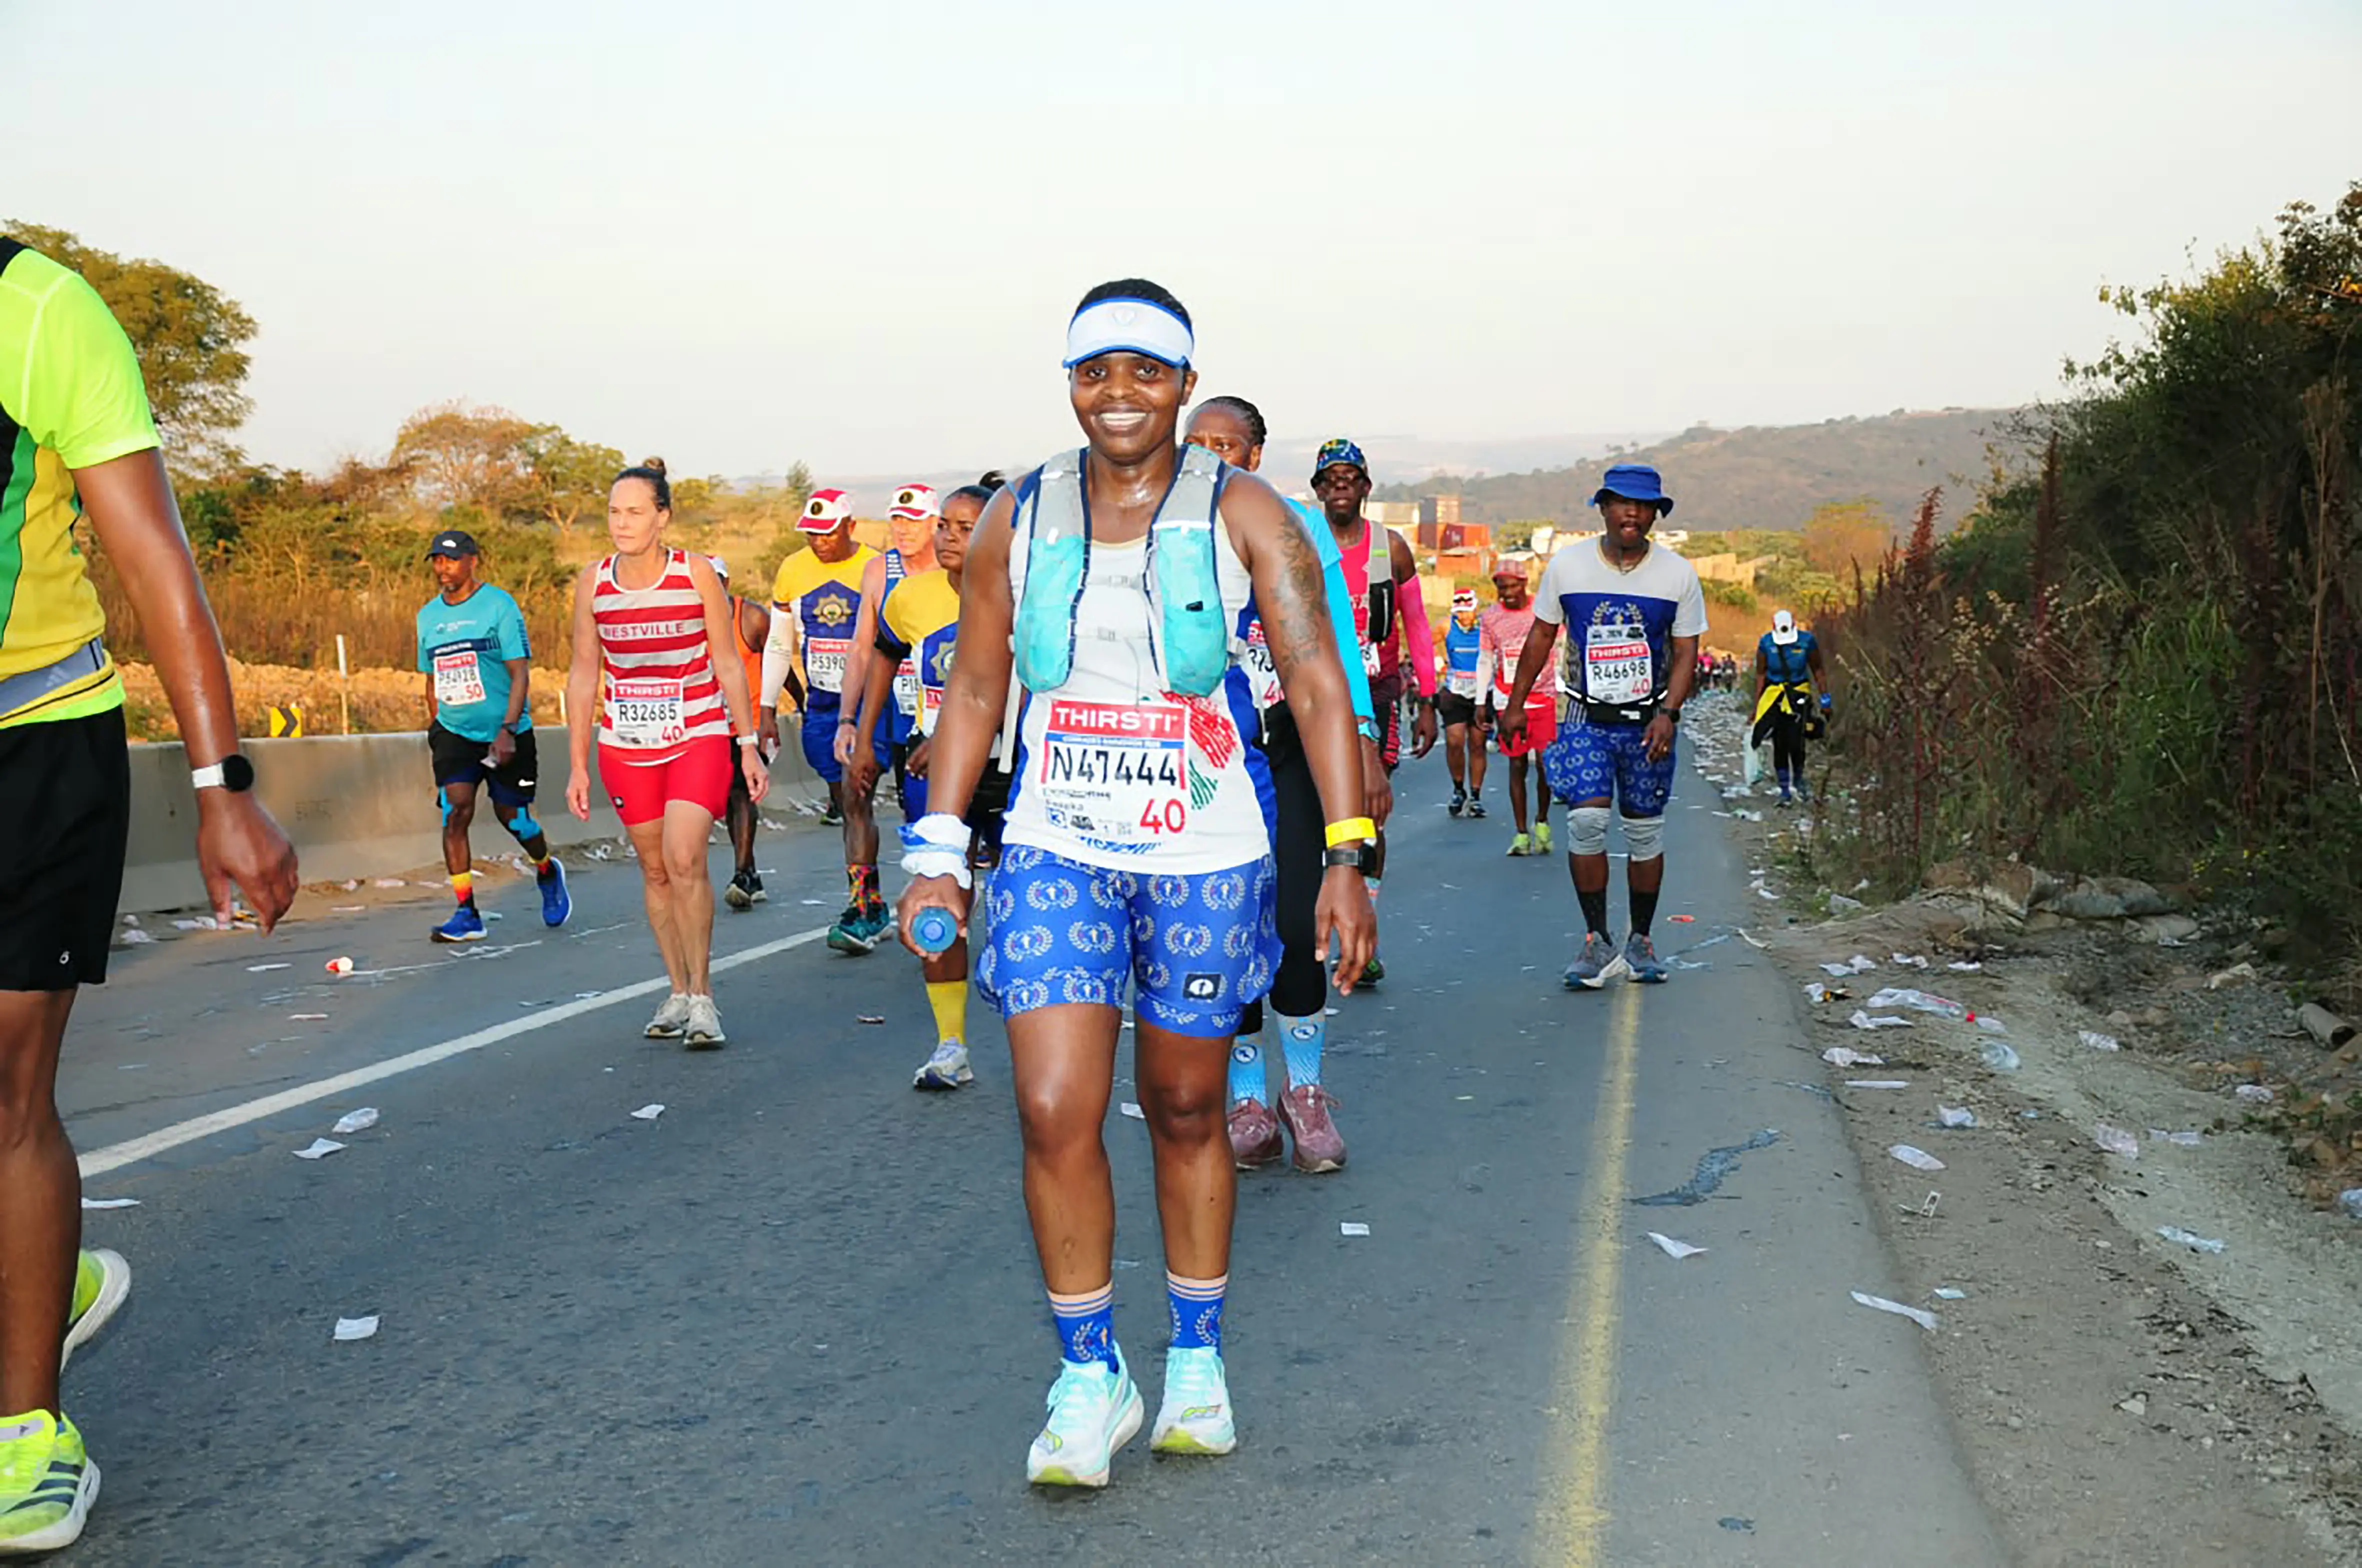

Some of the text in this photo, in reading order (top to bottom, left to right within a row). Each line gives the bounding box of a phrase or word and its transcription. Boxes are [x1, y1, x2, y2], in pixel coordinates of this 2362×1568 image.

[1592, 660, 1647, 681] R46698
[466, 683, 482, 699] 50
[618, 686, 676, 696] THIRSTI
[1631, 678, 1650, 694] 40
[619, 703, 677, 722] R32685
[1055, 706, 1172, 732] THIRSTI
[662, 726, 684, 742] 40
[1051, 745, 1177, 786] N47444
[1140, 798, 1186, 834] 40
